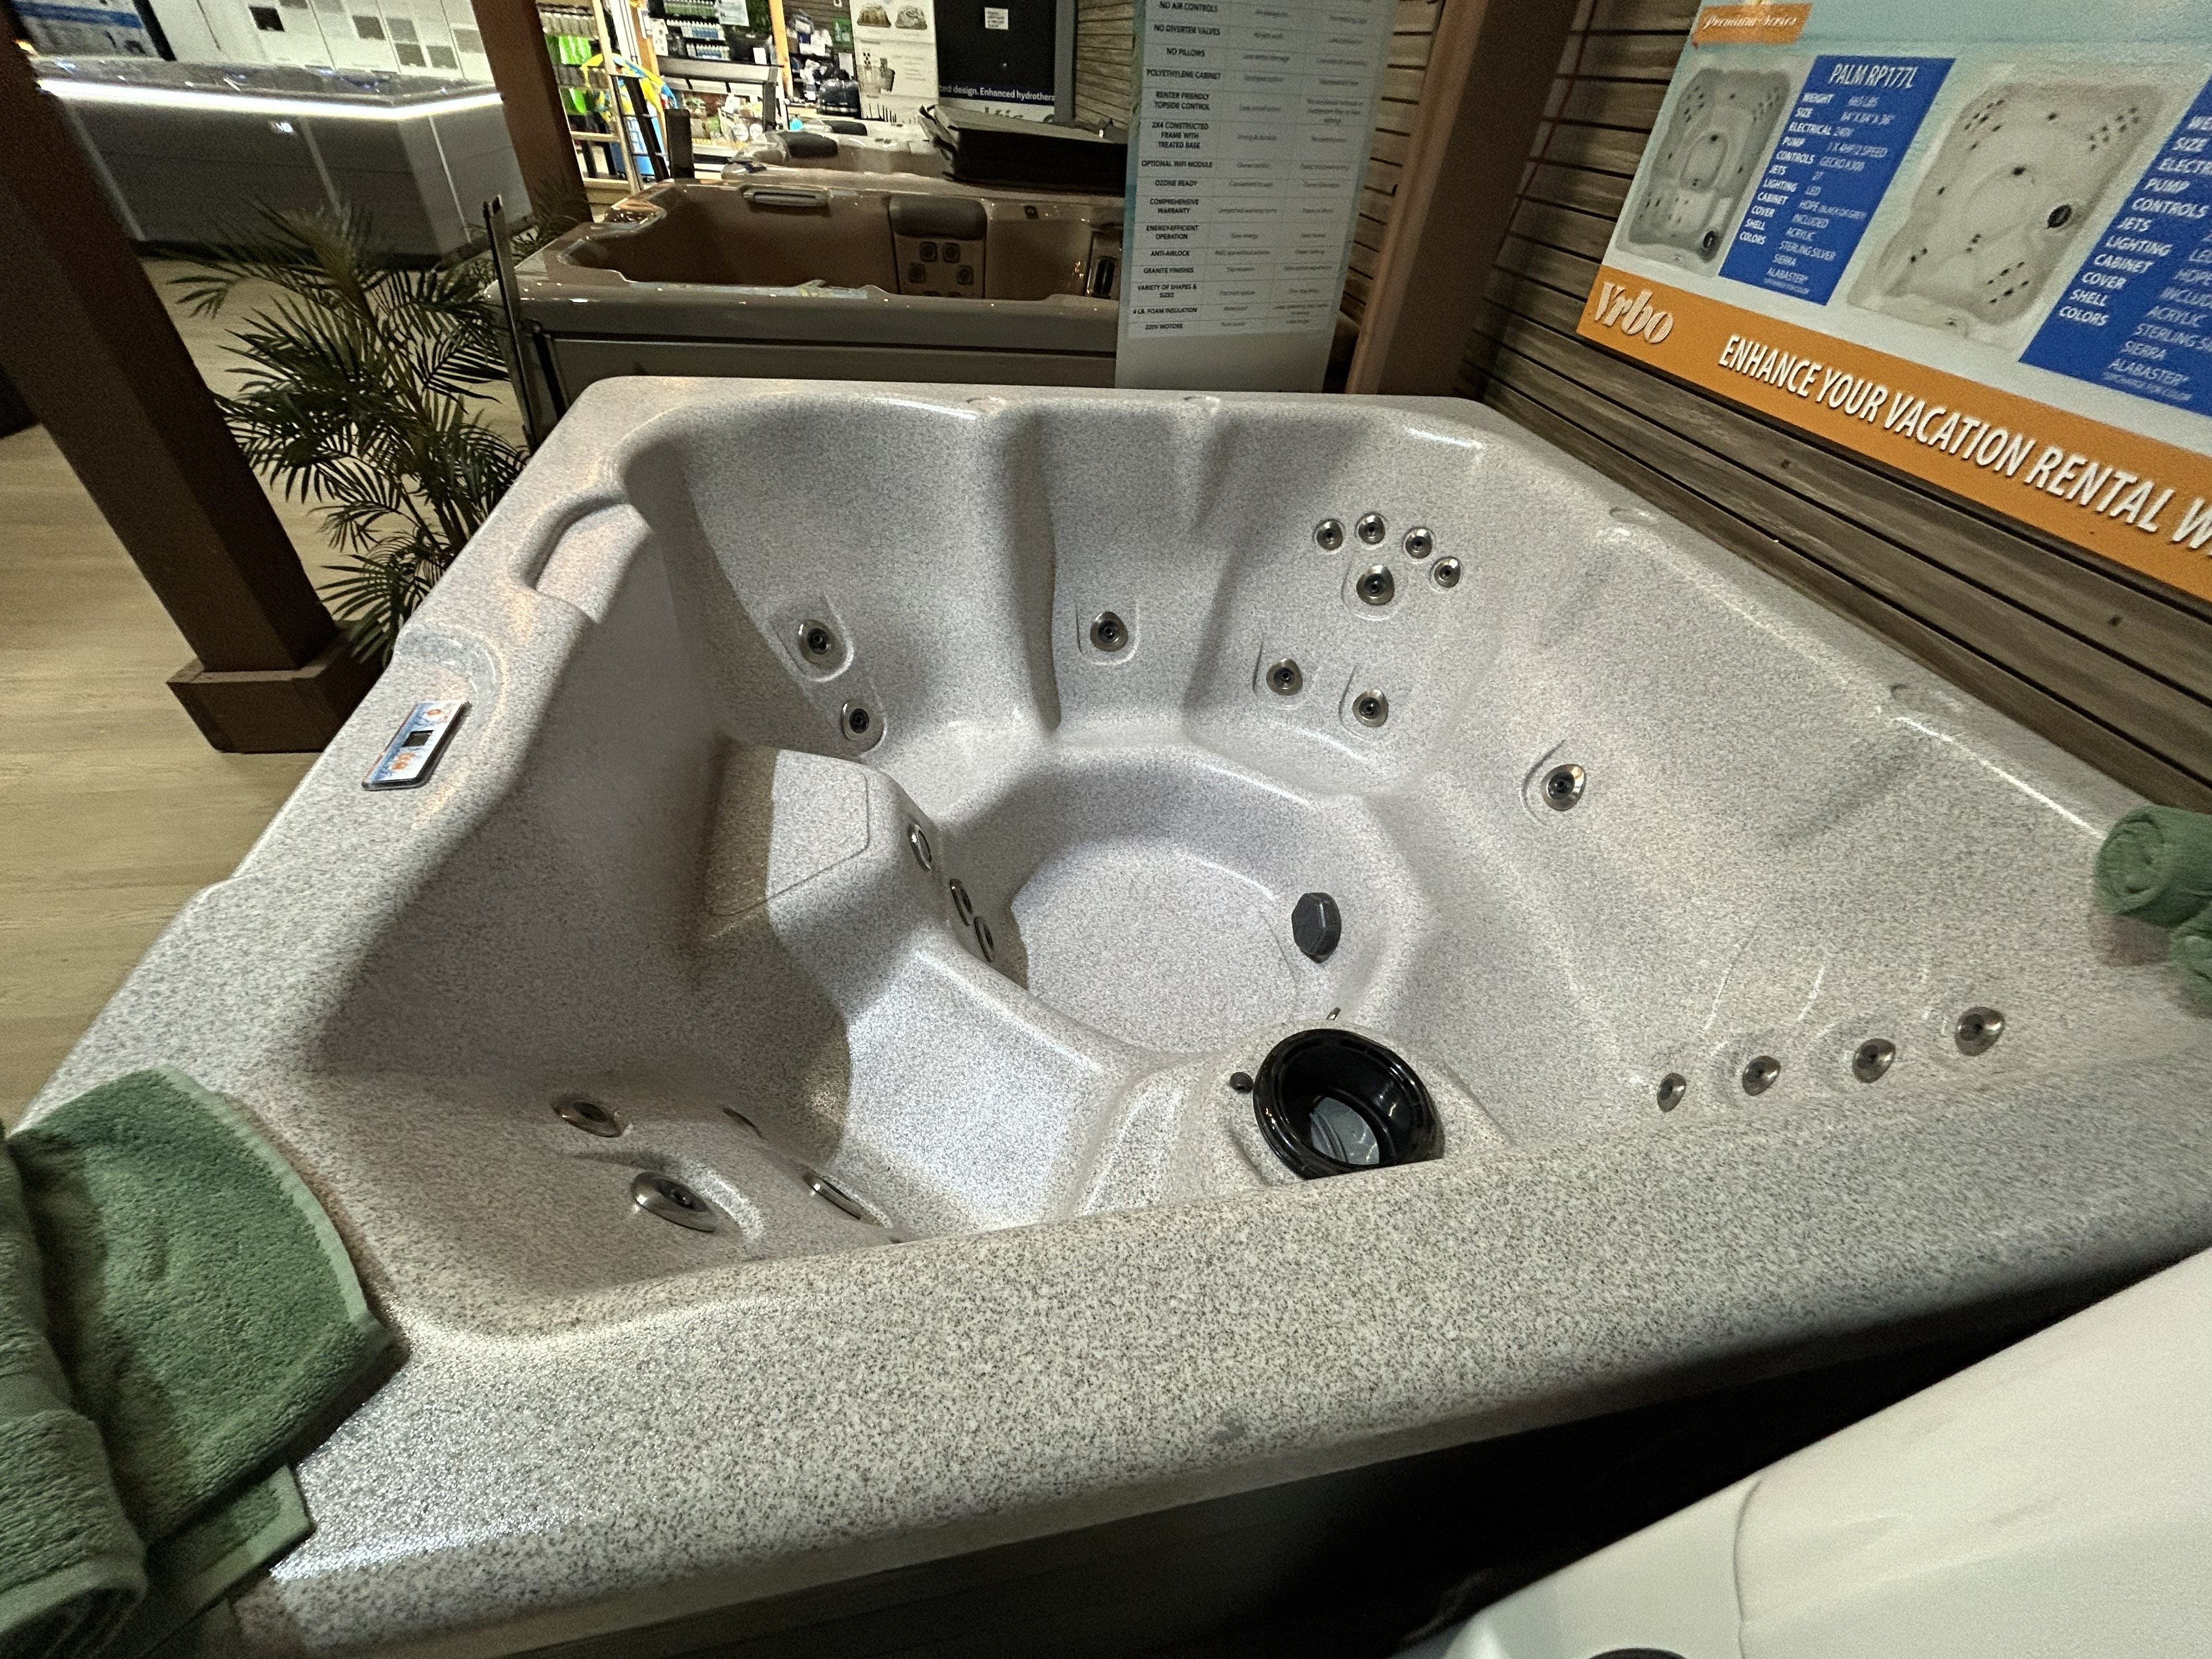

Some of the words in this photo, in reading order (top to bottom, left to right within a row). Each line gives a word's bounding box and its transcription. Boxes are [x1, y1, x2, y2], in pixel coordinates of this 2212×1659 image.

[1184, 3, 1218, 12] CONTROLS
[1165, 25, 1197, 33] DIVERTER
[1147, 69, 1194, 78] POLYETHYLENE
[1829, 63, 1869, 84] PALM
[1866, 65, 1918, 88] RP177L
[953, 84, 980, 97] design.
[980, 87, 1015, 98] Enhanced
[1802, 92, 1834, 104] WEIGHT
[1795, 107, 1813, 118] SIZE
[1165, 122, 1209, 130] CONSTRUCTED
[1788, 121, 1831, 136] ELECTRICAL
[1782, 136, 1805, 147] PUMP
[2171, 137, 2209, 152] SIZE
[1776, 150, 1816, 165] CONTROLS
[1769, 165, 1787, 176] JETS
[1763, 178, 1798, 193] LIGHTING
[1805, 185, 1821, 196] LED
[2142, 177, 2191, 195] PUMP
[1757, 191, 1788, 205] CABINET
[1751, 205, 1776, 218] COVER
[1791, 213, 1829, 229] INCLUDED
[2131, 198, 2211, 219] CONTROLS
[1745, 218, 1765, 230] SHELL
[1785, 227, 1817, 241] ACRYLIC
[2117, 217, 2152, 233] JETS
[1740, 230, 1767, 245] COLORS
[1779, 240, 1810, 256] STERLING
[1810, 246, 1836, 262] SILVER
[2105, 235, 2174, 257] LIGHTING
[1772, 253, 1797, 267] SIERRA
[2094, 253, 2154, 274] CABINET
[2081, 272, 2127, 290] COVER
[1594, 281, 1674, 344] Vrbo
[2069, 288, 2108, 307] SHELL
[2144, 305, 2208, 328] ACRYLIC
[2058, 306, 2109, 326] COLORS
[2133, 323, 2199, 348] STERLING
[2119, 340, 2166, 361] SIERRA
[1718, 333, 1822, 397] ENHANCE
[1816, 368, 1888, 422] YOUR
[1883, 392, 2036, 477] VACATION
[2023, 445, 2176, 533] RENTAL
